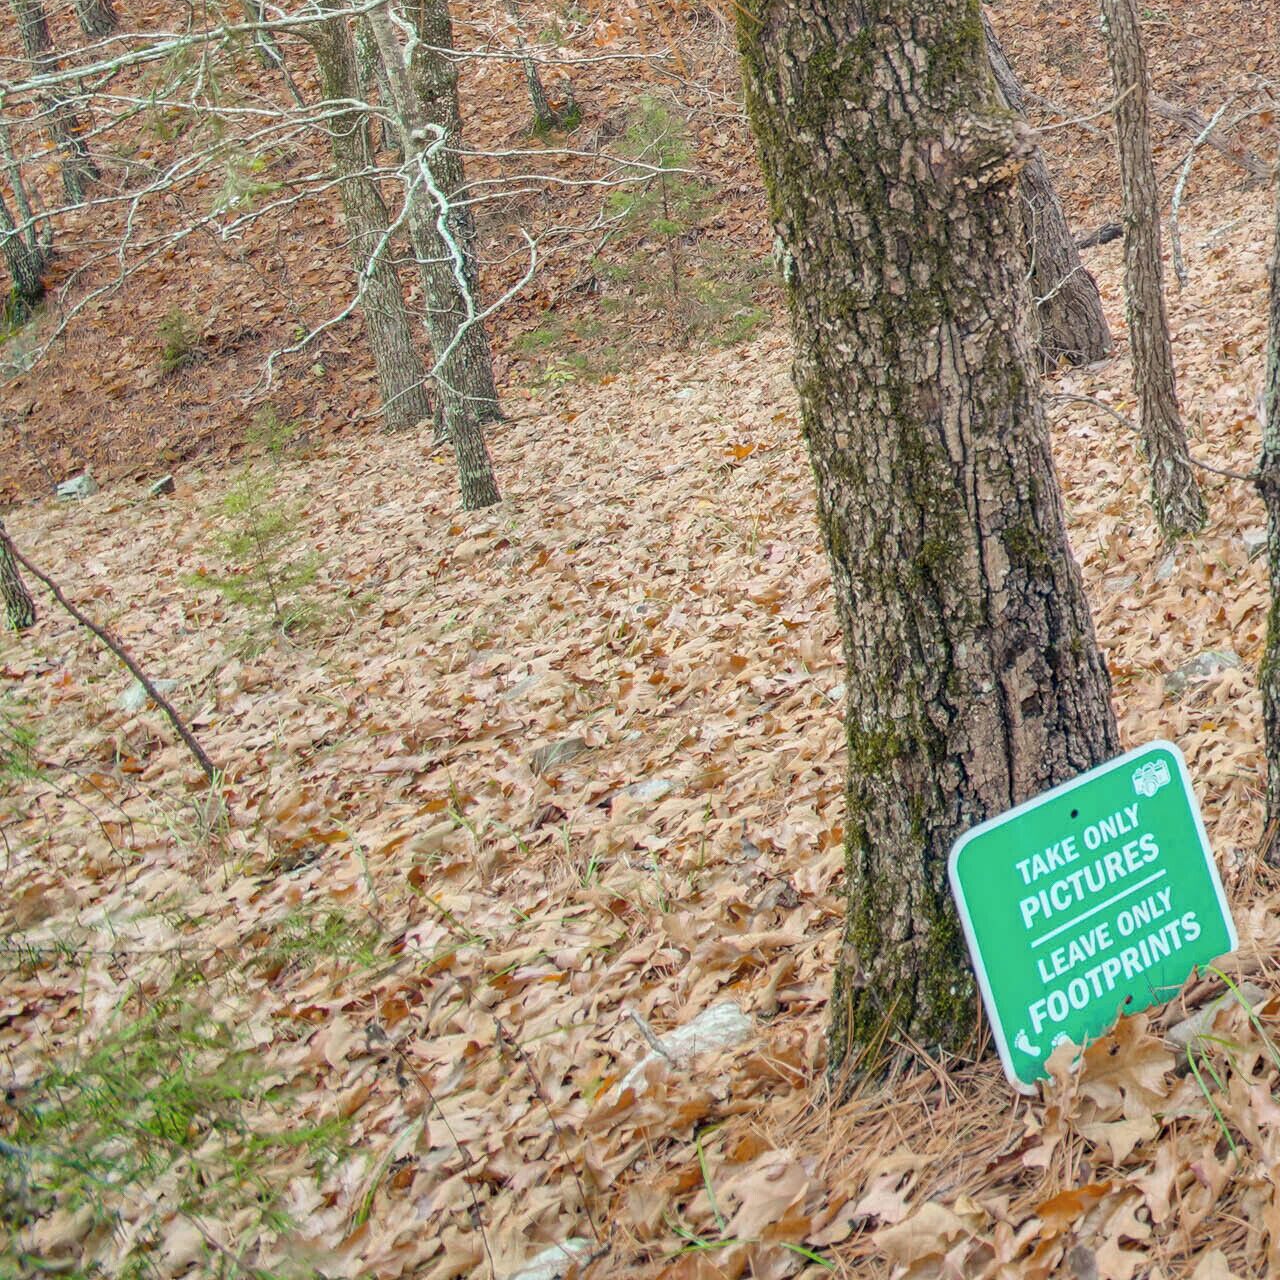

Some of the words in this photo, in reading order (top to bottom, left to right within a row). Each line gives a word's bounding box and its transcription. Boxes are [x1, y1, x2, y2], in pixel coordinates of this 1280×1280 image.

[1016, 834, 1080, 885] TAKE
[1083, 802, 1140, 850] ONLY
[1020, 833, 1160, 930] PICTURES
[1028, 911, 1202, 1034] FOOTPRINTS
[1037, 922, 1114, 984] LEAVE
[1116, 886, 1174, 937] ONLY
